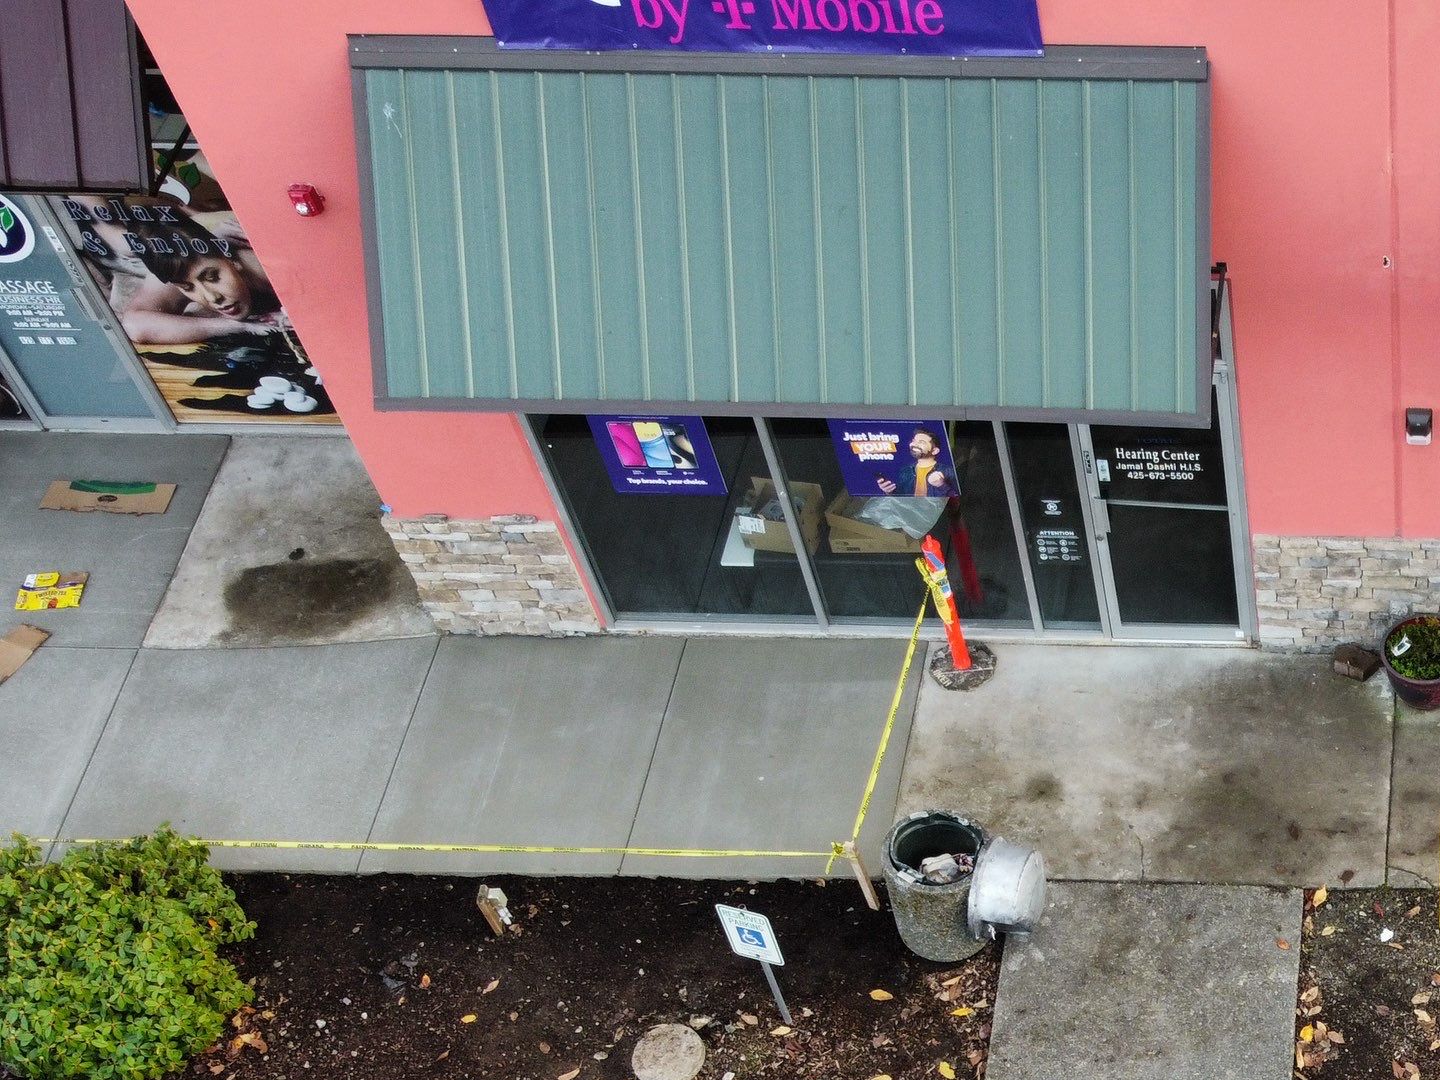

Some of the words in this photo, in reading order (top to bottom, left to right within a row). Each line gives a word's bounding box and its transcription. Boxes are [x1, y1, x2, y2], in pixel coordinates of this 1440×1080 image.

[631, 0, 690, 43] by
[772, 0, 946, 36] Mobile
[62, 199, 179, 222] Relax
[82, 231, 107, 256] &
[122, 232, 232, 258] Enjoy
[0, 280, 58, 294] ASSAGE
[0, 296, 44, 304] USINESS
[843, 432, 868, 442] Just
[868, 432, 900, 444] bring
[857, 442, 893, 452] YOUR
[858, 452, 894, 462] phone
[1116, 447, 1159, 463] Hearing
[1162, 450, 1200, 461] Center
[1116, 463, 1143, 471] Jamal
[627, 477, 641, 485] Top
[1127, 472, 1194, 480] 425-673-5500
